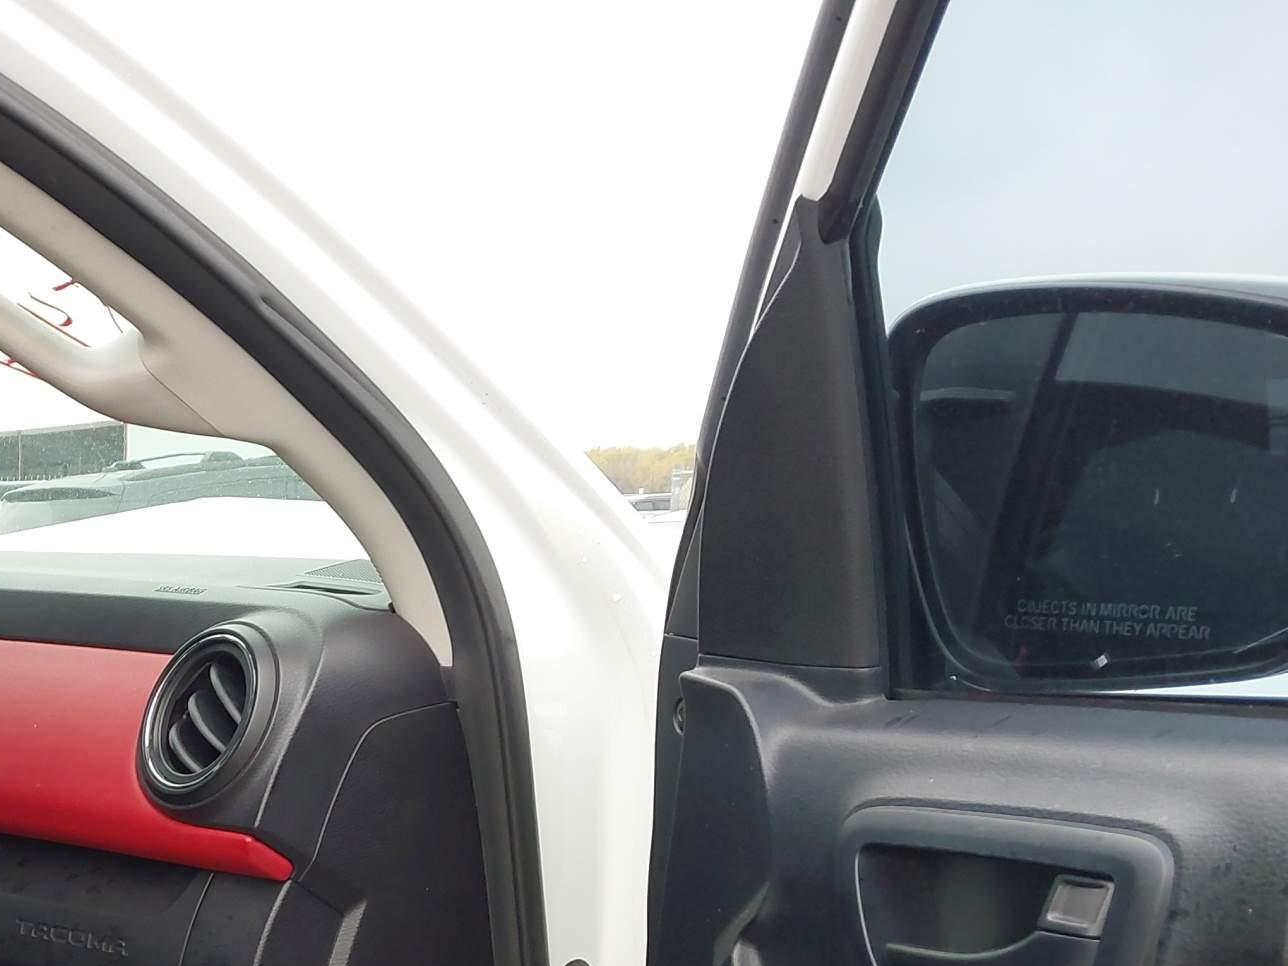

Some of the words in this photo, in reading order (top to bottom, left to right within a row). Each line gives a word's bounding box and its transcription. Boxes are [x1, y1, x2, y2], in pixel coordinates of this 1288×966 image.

[1017, 599, 1076, 616] OBJECTS
[1080, 602, 1096, 617] IN
[1099, 603, 1160, 620] MIRROR
[1165, 606, 1199, 622] ARE
[1004, 615, 1057, 631] CLOSER
[1061, 617, 1100, 633] THAN
[1103, 620, 1143, 637] THEY
[1146, 623, 1211, 640] APPEAR
[15, 918, 129, 957] TACOMA
